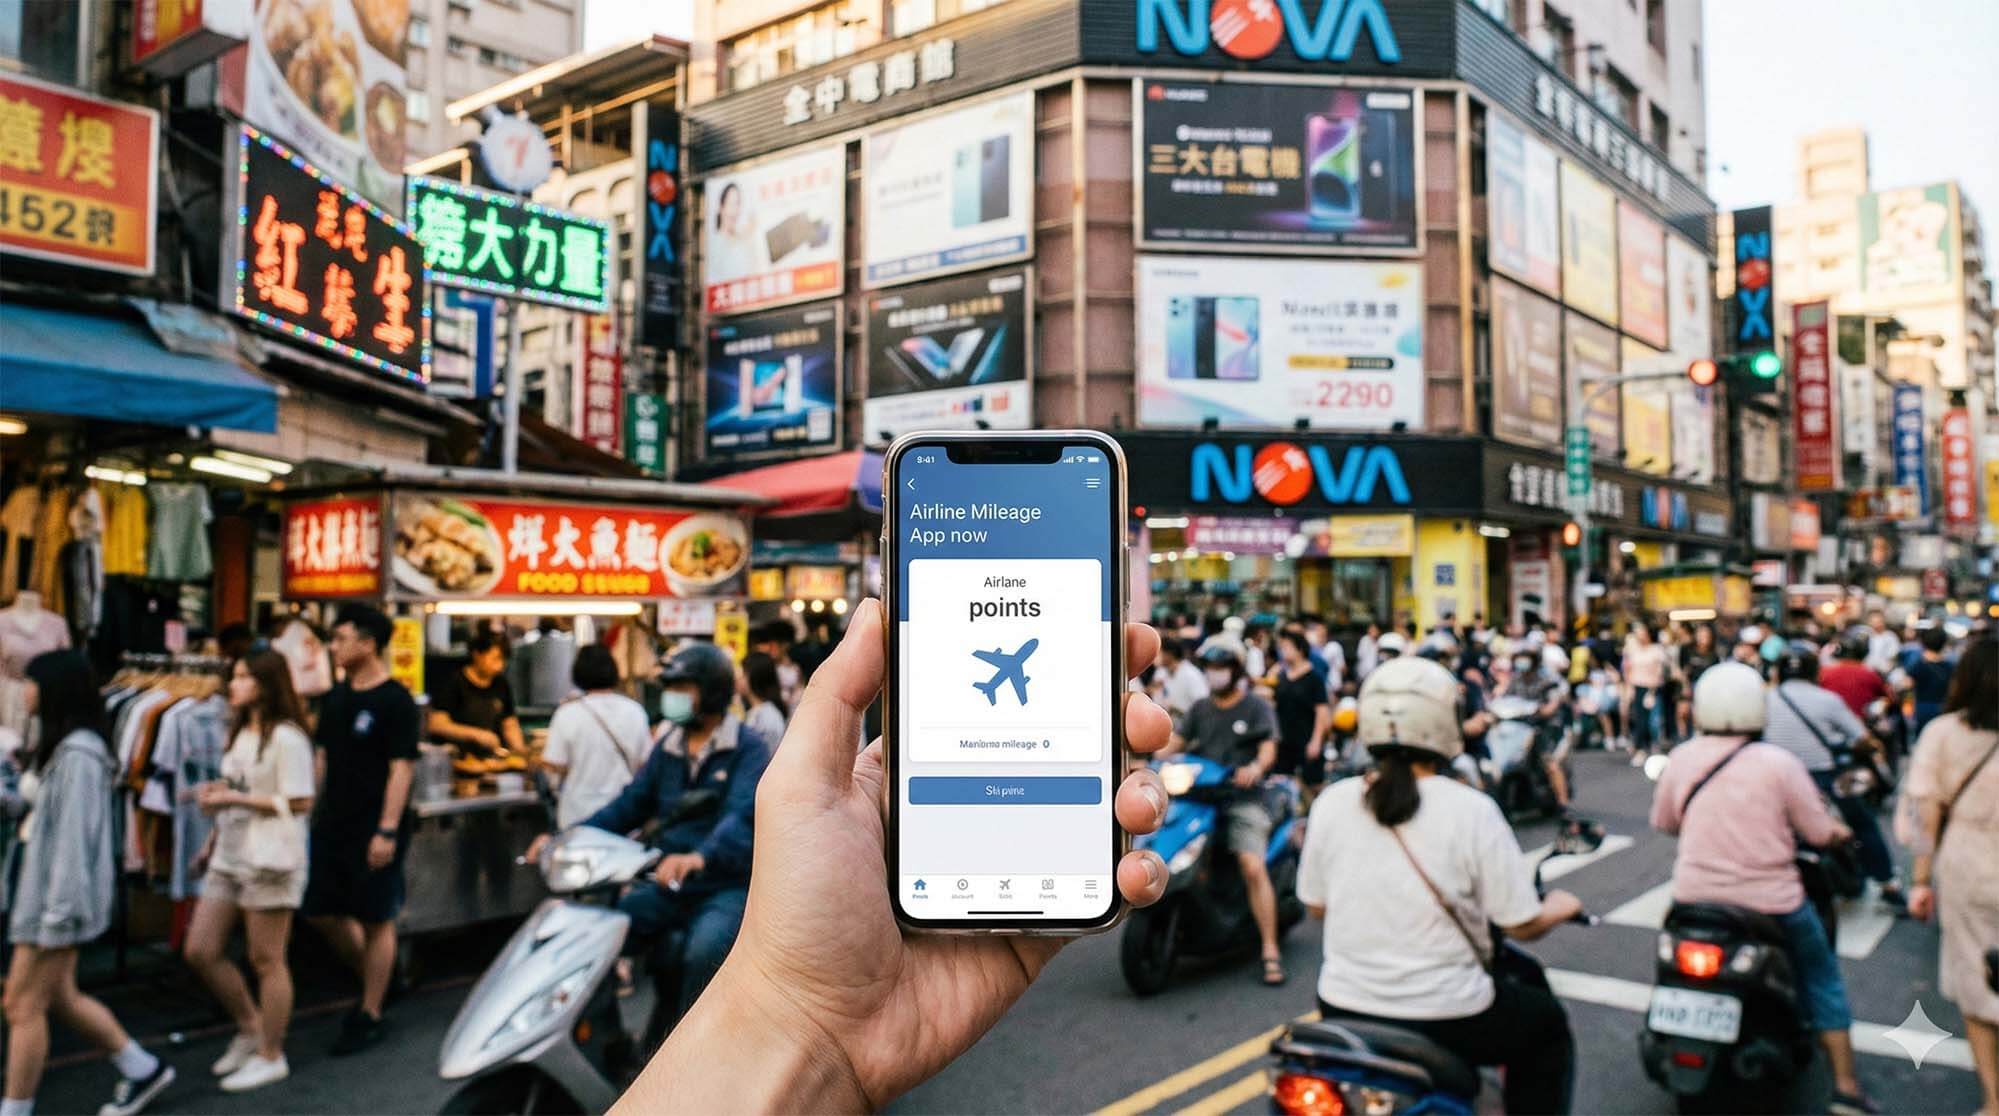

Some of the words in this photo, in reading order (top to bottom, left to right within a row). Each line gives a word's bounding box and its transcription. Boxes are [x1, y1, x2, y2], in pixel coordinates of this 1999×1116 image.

[1136, 0, 1401, 63] NOVA
[647, 139, 677, 263] NOVA
[1737, 231, 1771, 341] NOVA
[1316, 379, 1394, 409] 2290
[1190, 441, 1412, 506] NOVA
[909, 503, 966, 521] Airline
[971, 503, 1042, 524] Mileage
[909, 528, 946, 547] App
[951, 529, 988, 543] now
[984, 576, 1027, 588] Airlane
[969, 597, 1041, 623] points
[1001, 739, 1037, 751] mileage
